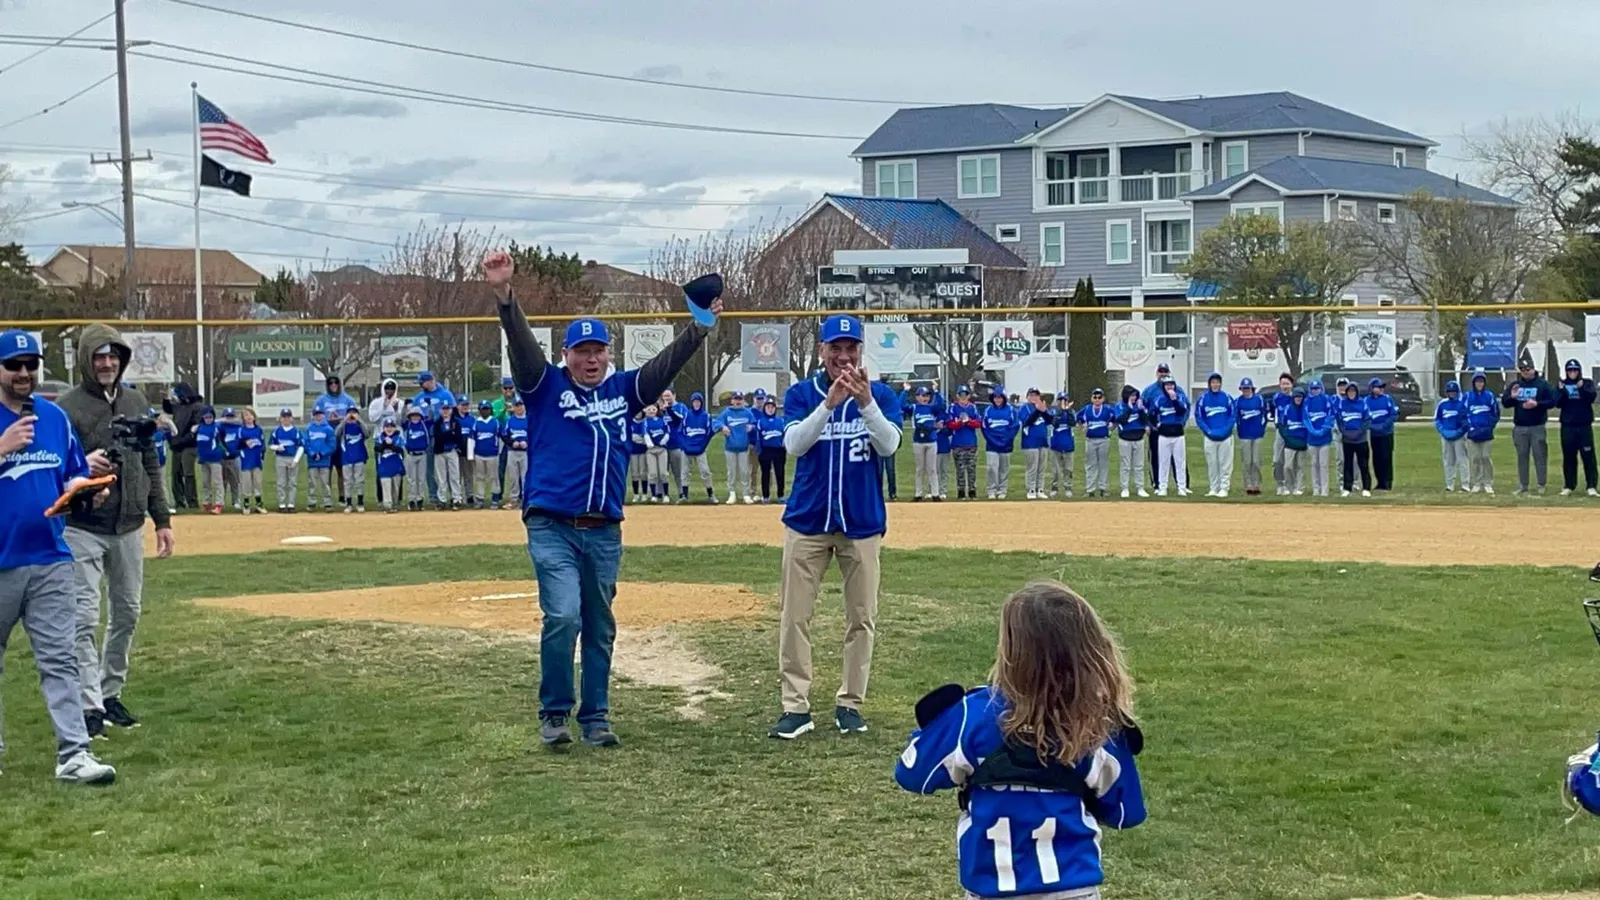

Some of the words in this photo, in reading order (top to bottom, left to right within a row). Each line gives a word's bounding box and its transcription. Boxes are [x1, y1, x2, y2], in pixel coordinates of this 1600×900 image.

[867, 267, 895, 275] STRIKE
[823, 286, 861, 298] HOME
[938, 284, 980, 296] GUEST
[873, 314, 908, 322] INNING
[581, 322, 592, 336] B
[840, 319, 851, 332] B
[15, 335, 28, 349] B
[235, 341, 248, 352] AL
[250, 341, 296, 354] JACKSON
[299, 341, 324, 352] FIELD
[993, 336, 1027, 351] Rita's
[617, 416, 627, 442] 3
[849, 438, 871, 462] 25
[5, 450, 60, 466] rigantine
[986, 817, 1060, 892] 11
